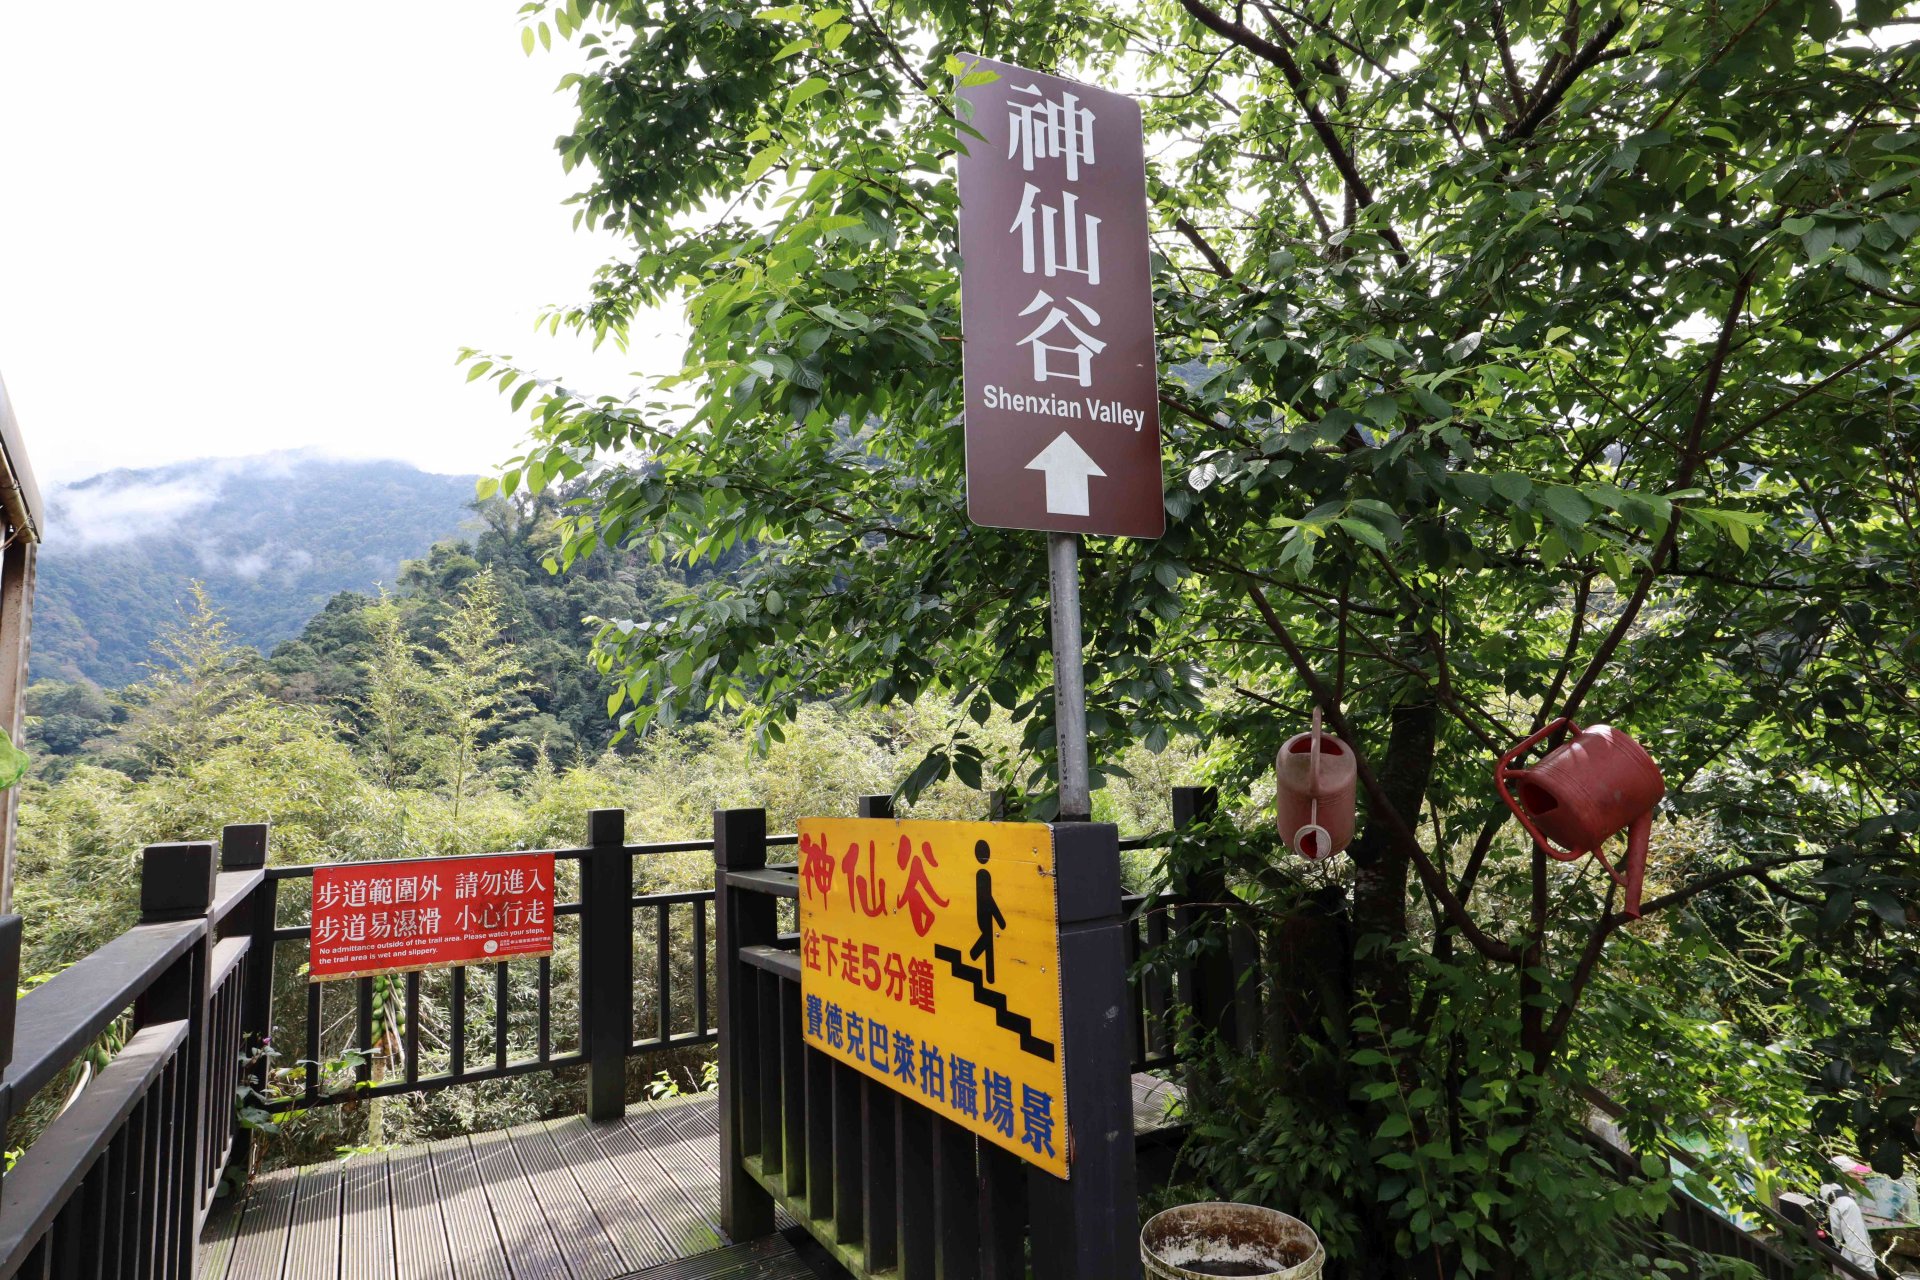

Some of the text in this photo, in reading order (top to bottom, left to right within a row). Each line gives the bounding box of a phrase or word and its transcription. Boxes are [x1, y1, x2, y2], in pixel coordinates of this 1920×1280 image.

[1006, 83, 1107, 388] 神仙谷
[983, 384, 1145, 432] Shenxian Valley
[315, 868, 546, 911] 步道範圍外 請勿進入
[800, 832, 950, 937] 神仙谷
[314, 898, 546, 945] 步道易濕滑 小心行走
[332, 944, 375, 954] admittance
[377, 941, 404, 949] outside
[428, 936, 443, 944] trail
[319, 957, 332, 965] the
[333, 955, 349, 963] trail
[350, 953, 368, 961] area
[392, 949, 407, 957] and
[408, 947, 438, 956] slippery.
[803, 927, 936, 1014] 往下走5分鐘
[805, 993, 1057, 1159] 賽德克巴萊拍攝場景
